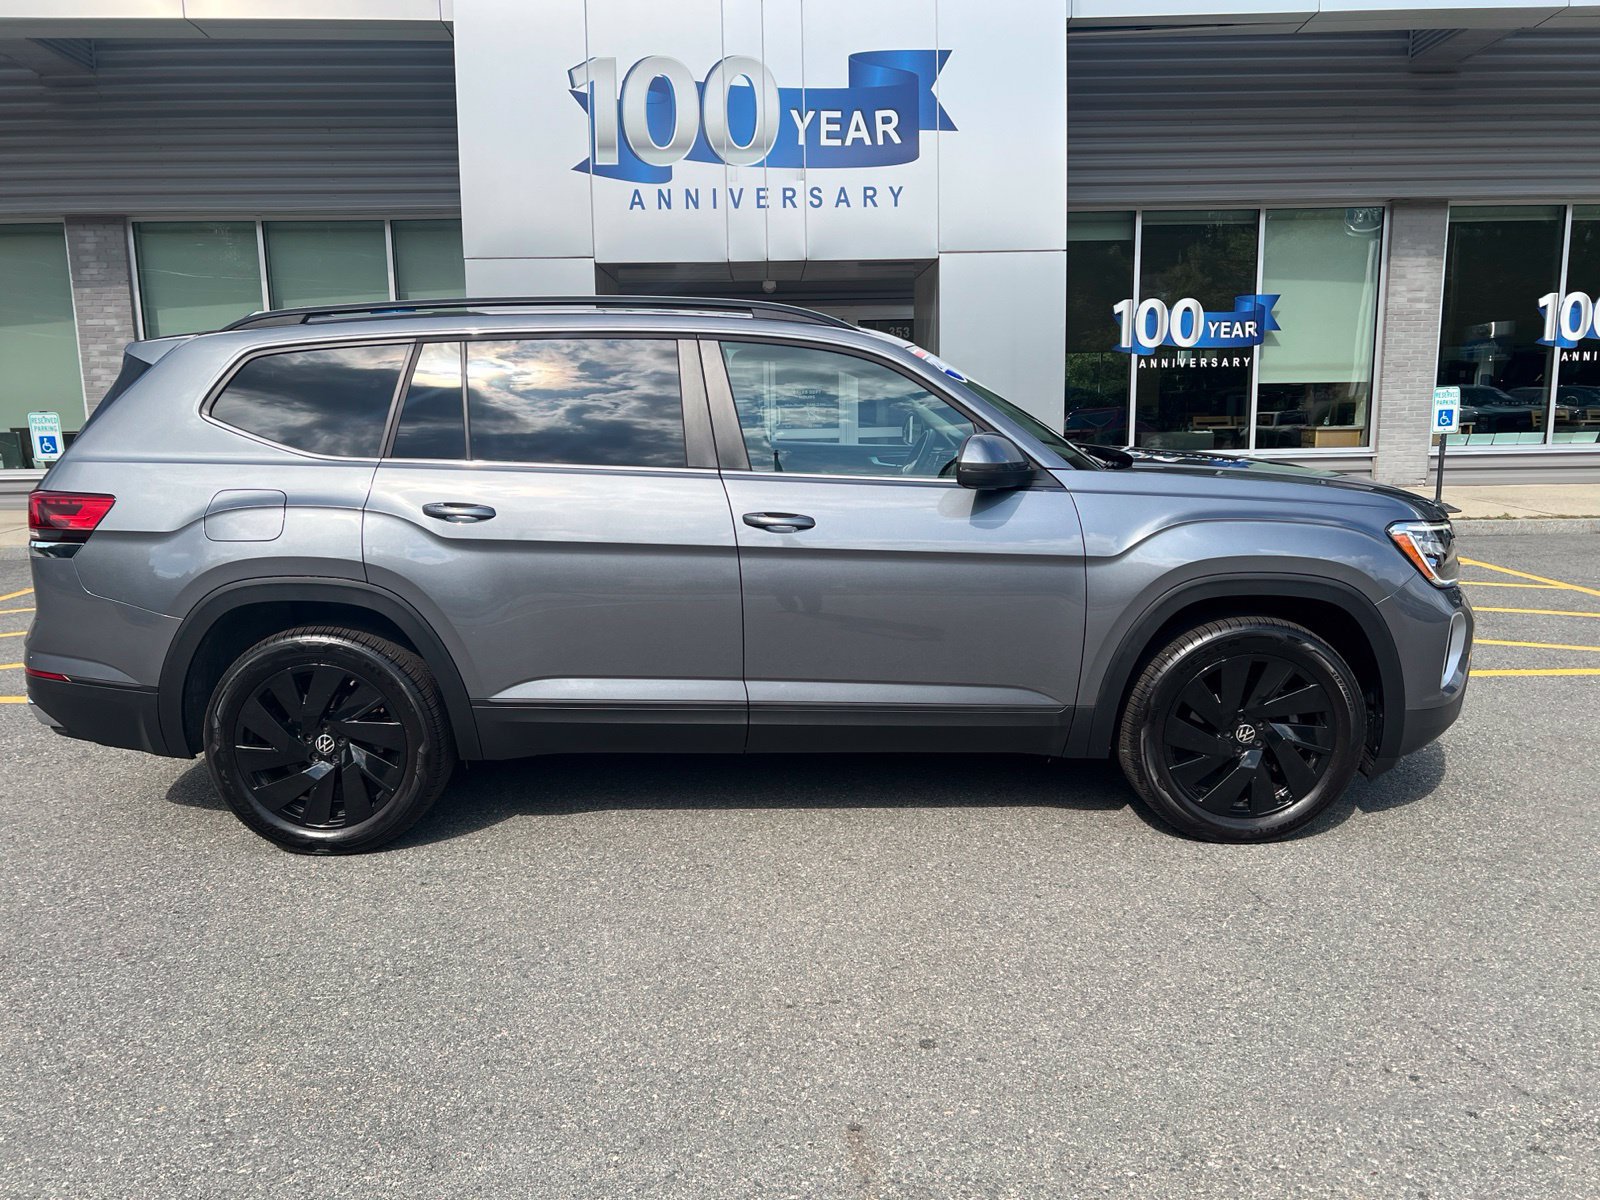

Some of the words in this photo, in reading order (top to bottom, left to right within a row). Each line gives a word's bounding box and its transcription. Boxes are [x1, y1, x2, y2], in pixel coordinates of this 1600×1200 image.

[567, 55, 780, 166] 100
[790, 109, 902, 146] YEAR
[629, 185, 904, 210] ANNIVERSARY
[1113, 297, 1205, 348] 100
[1208, 321, 1258, 339] YEAR
[1537, 291, 1600, 342] 10
[1139, 357, 1251, 369] ANNIVERSARY
